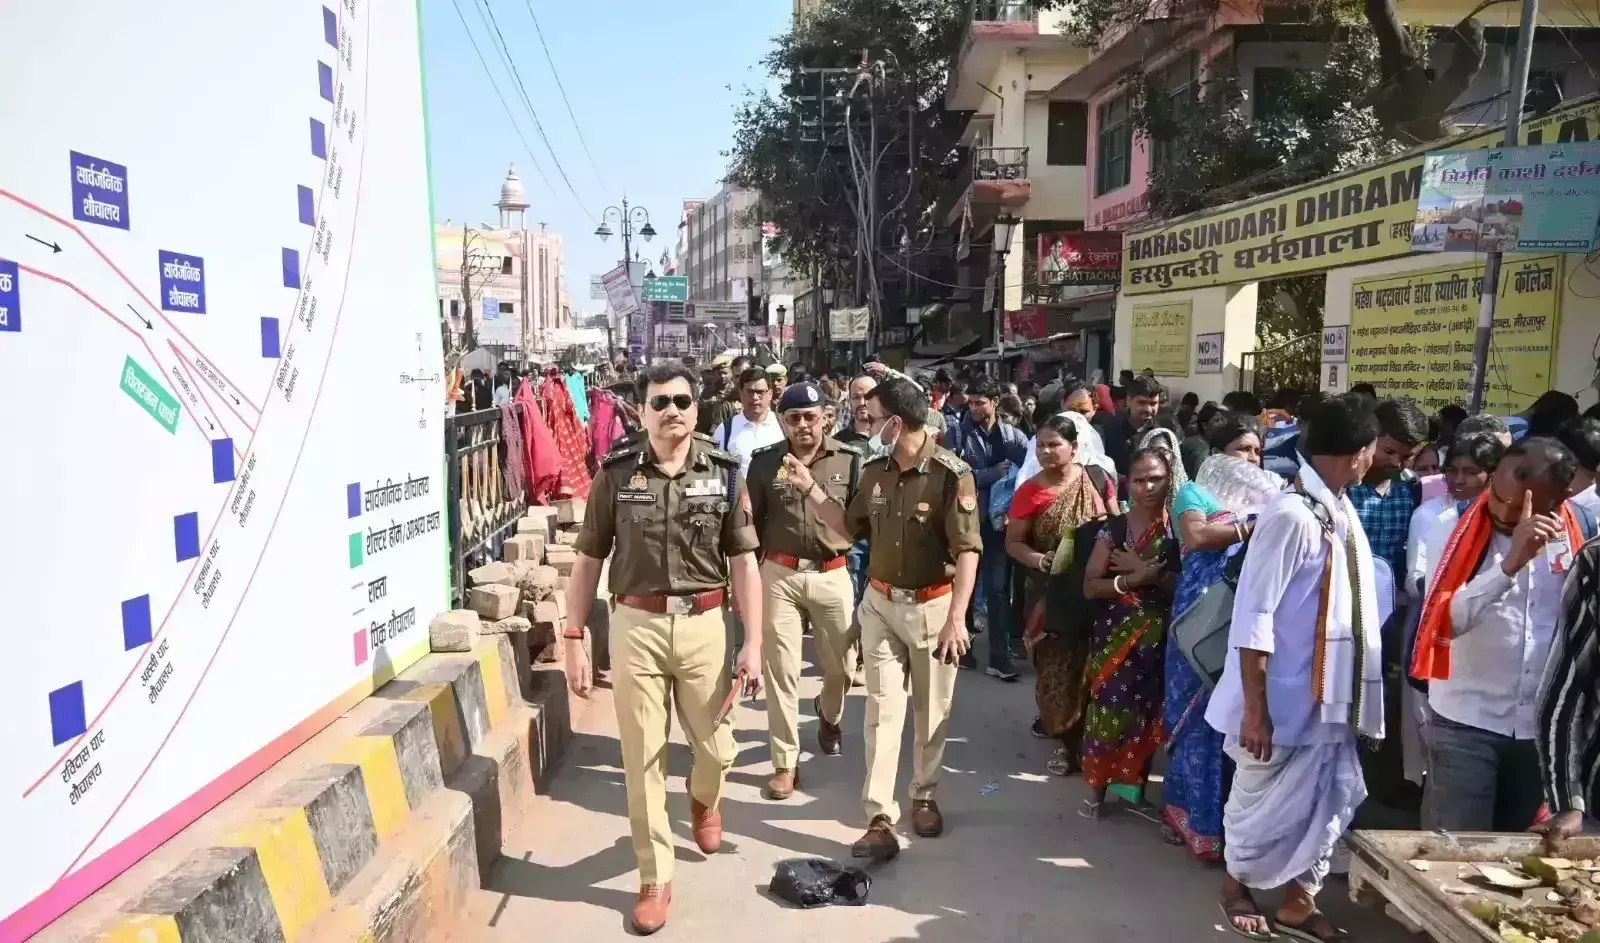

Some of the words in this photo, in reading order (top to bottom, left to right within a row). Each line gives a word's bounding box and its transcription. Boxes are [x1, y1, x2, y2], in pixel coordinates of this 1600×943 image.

[76, 164, 123, 193] सार्वजनिक
[1499, 164, 1549, 181] काशी
[83, 193, 120, 222] शौचालय
[1129, 203, 1287, 261] HARASUNDARI
[1295, 165, 1425, 228] DHRAM
[163, 258, 201, 282] सार्वजनिक
[1129, 249, 1223, 288] हरसुन्दरी
[1234, 218, 1385, 270] धर्मशाला
[169, 285, 199, 308] शौचालय
[1355, 286, 1372, 309] महेश
[1515, 263, 1554, 294] कॉलेज
[1199, 341, 1210, 354] NO
[1324, 333, 1336, 346] NO
[1197, 357, 1220, 365] PARKING
[238, 488, 256, 528] शौचालय
[364, 478, 402, 512] सार्वजनिक
[403, 472, 430, 501] शौचालय
[366, 526, 387, 556] शेल्टर
[193, 555, 213, 595] हनुमान
[210, 538, 221, 559] घाट
[201, 568, 222, 609] शौचालय
[367, 576, 388, 603] रास्ता
[370, 620, 386, 651] पिंक
[388, 609, 416, 640] शौचालय
[141, 653, 158, 687] अस्सी
[156, 637, 170, 659] घाट
[148, 661, 174, 704] शौचालय
[60, 745, 91, 784] रविदास
[90, 728, 106, 752] घाट
[69, 761, 103, 806] शौचालय
